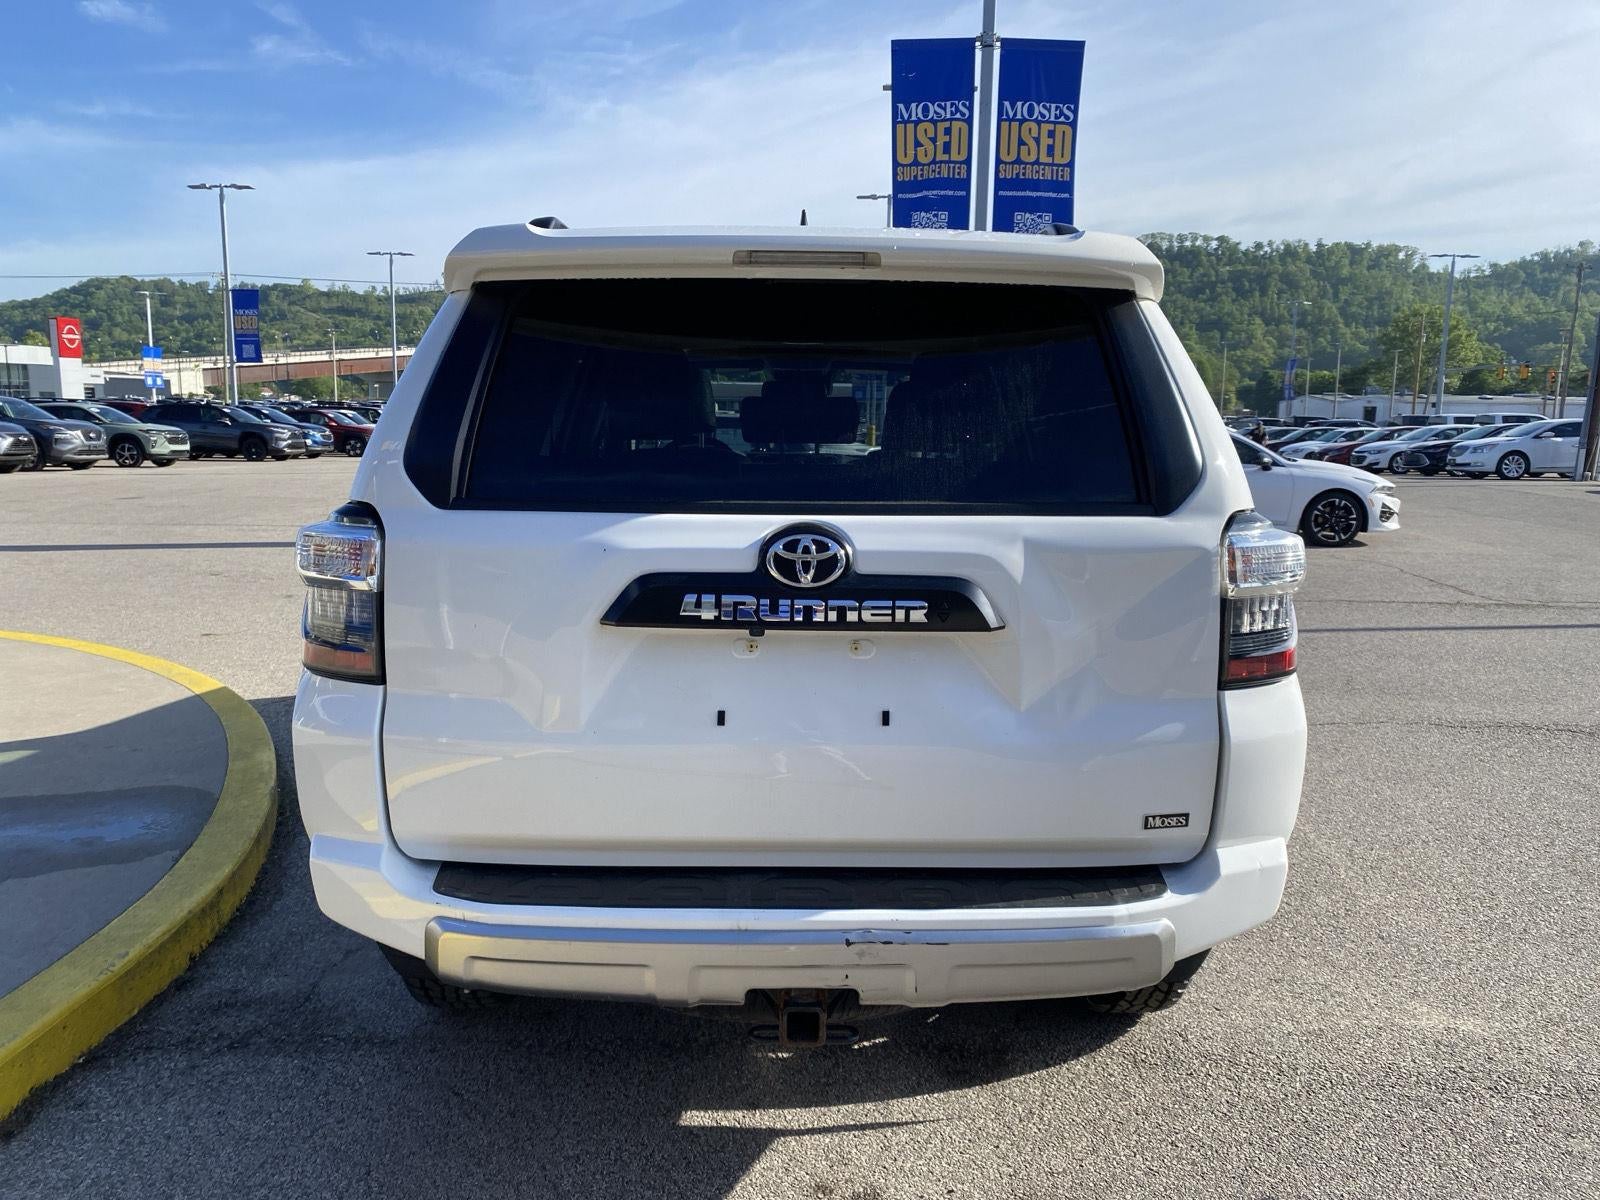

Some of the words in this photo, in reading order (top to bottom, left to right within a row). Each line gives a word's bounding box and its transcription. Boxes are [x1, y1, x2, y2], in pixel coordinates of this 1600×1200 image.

[896, 100, 970, 122] MOSES
[1001, 100, 1075, 123] MOSES
[896, 121, 969, 165] USED
[1000, 121, 1073, 164] USED
[897, 163, 967, 182] SUPERCENTER
[999, 163, 1070, 182] SUPERCENTER
[235, 316, 258, 329] USED
[1147, 816, 1186, 828] MOSES
